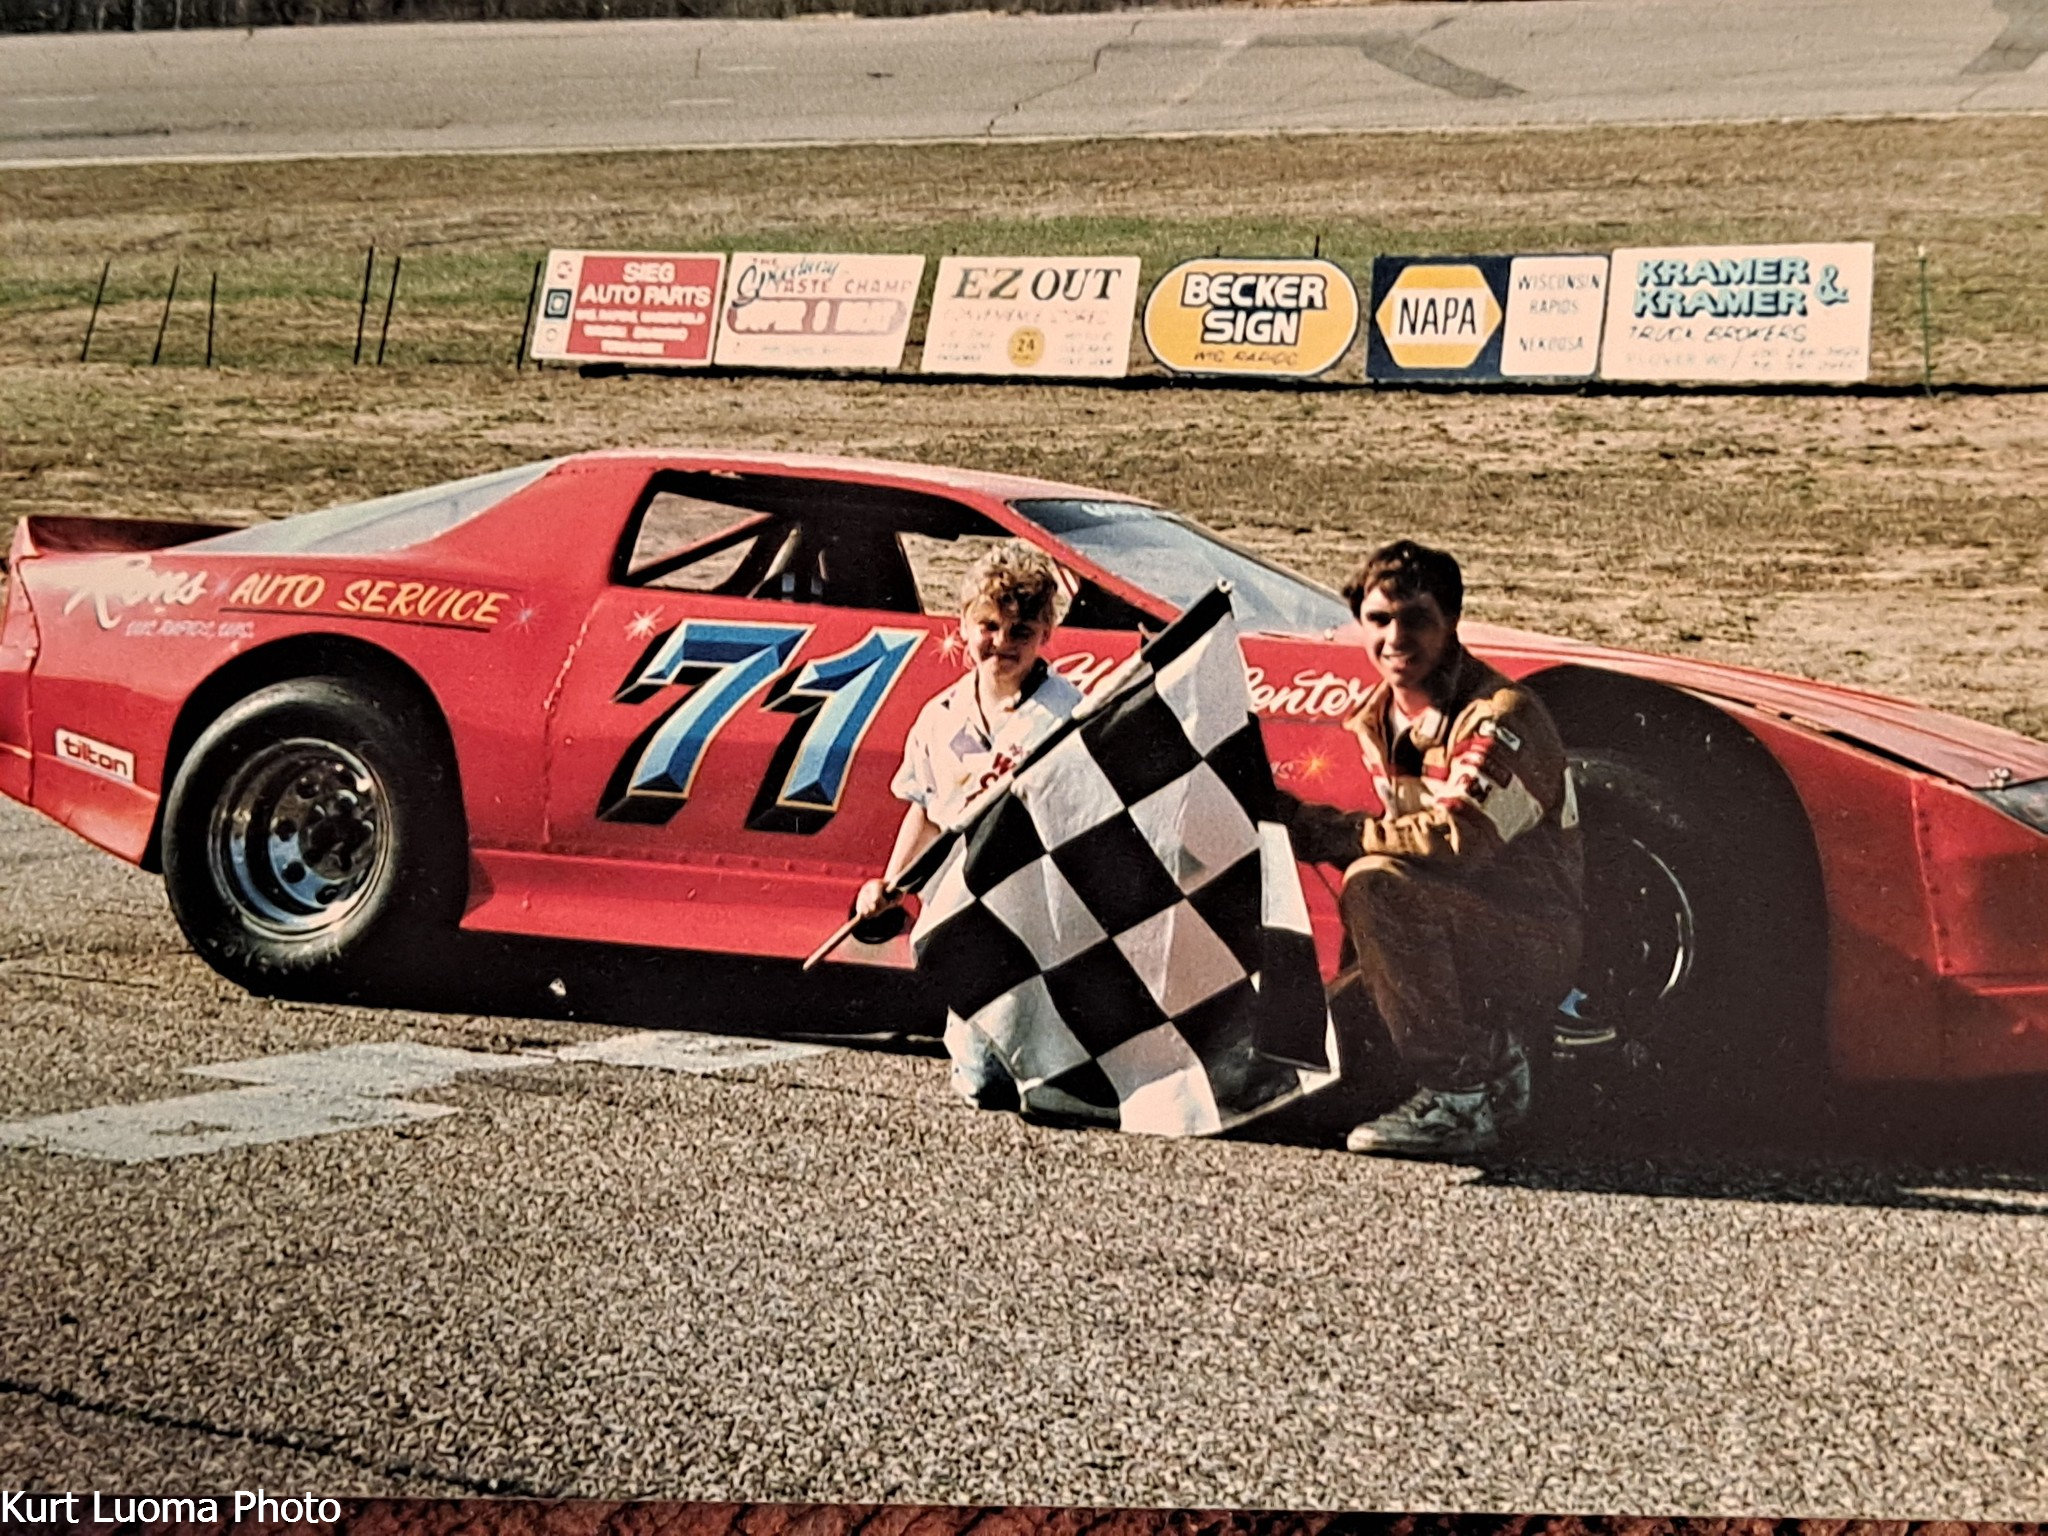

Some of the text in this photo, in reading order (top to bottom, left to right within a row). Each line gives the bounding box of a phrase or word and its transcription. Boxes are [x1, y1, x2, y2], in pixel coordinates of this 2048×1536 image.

[622, 261, 676, 284] SIEG
[952, 267, 1122, 301] EZ OUT
[1181, 272, 1327, 310] BECKER
[1518, 273, 1602, 291] WISCONSIN
[1637, 257, 1849, 306] KRAMER &
[580, 283, 712, 308] AUTO PARTS
[1634, 287, 1808, 319] KRAMER
[1201, 309, 1301, 346] SIGN
[1398, 297, 1477, 336] NAPA
[228, 572, 326, 608] AUTO
[336, 578, 511, 625] SERVICE
[596, 618, 930, 834] 71
[63, 737, 128, 776] tilton
